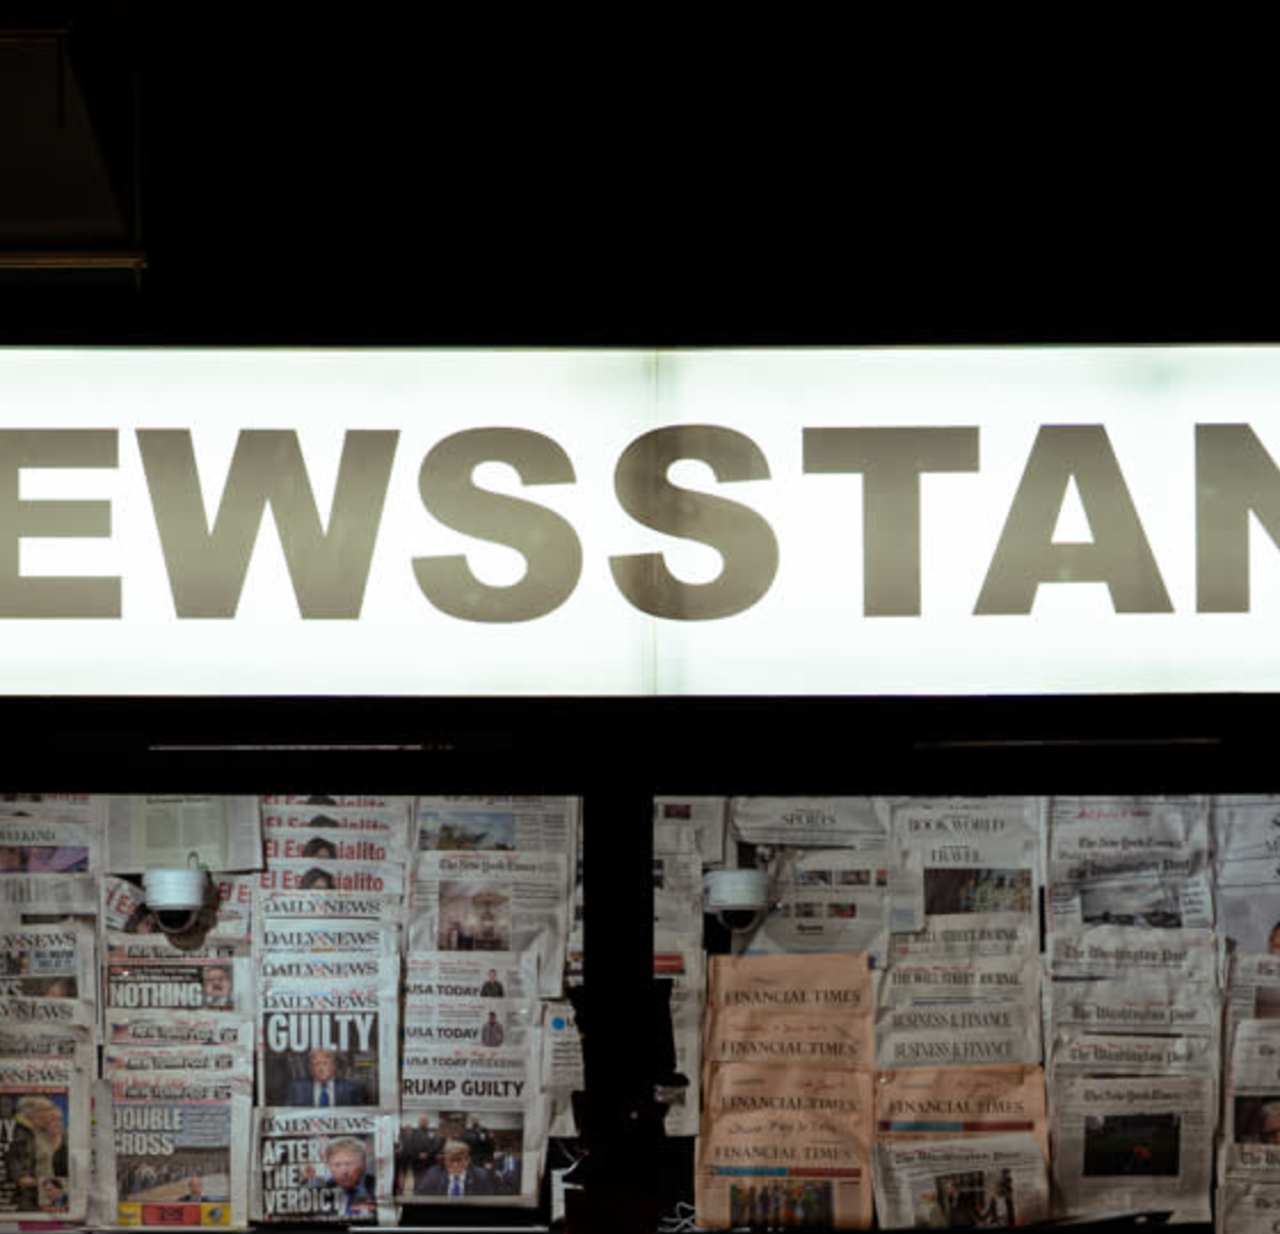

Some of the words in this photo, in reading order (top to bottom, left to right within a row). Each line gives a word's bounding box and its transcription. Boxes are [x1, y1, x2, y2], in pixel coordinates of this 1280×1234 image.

[264, 899, 318, 914] DAILY
[322, 901, 381, 914] NEWS
[21, 933, 77, 948] NEWS
[263, 930, 317, 946] DAILY
[321, 931, 380, 945] NEWS
[262, 963, 314, 978] DAILY
[320, 961, 379, 976] NEWS
[110, 982, 202, 1008] NOTHING
[405, 984, 433, 996] USA
[437, 984, 479, 997] TODAY
[725, 990, 806, 1004] FINANCIAL
[815, 990, 861, 1002] TIMES
[19, 1001, 74, 1018] NEWS
[262, 995, 311, 1009] DAILY
[321, 995, 379, 1009] NEWS
[266, 1014, 374, 1052] GUILTY
[405, 1027, 433, 1038] USA
[437, 1027, 479, 1039] TODAY
[720, 1040, 801, 1055] FINANCIAL
[809, 1041, 856, 1056] TIMES
[14, 1067, 72, 1083] NEWS
[404, 1079, 456, 1096] RUMP
[461, 1080, 524, 1096] GUILTY
[720, 1096, 801, 1111] FINANCIAL
[808, 1098, 856, 1111] TIMES
[888, 1100, 970, 1114] FINANCIAL
[977, 1100, 1024, 1114] TIMES
[262, 1117, 312, 1131] DAILY
[321, 1117, 376, 1131] NEWS
[263, 1140, 318, 1164] AFTER
[714, 1146, 797, 1160] FINANCIAL
[805, 1147, 852, 1160] TIMES
[263, 1164, 301, 1188] THE
[263, 1188, 341, 1216] VERDICT
